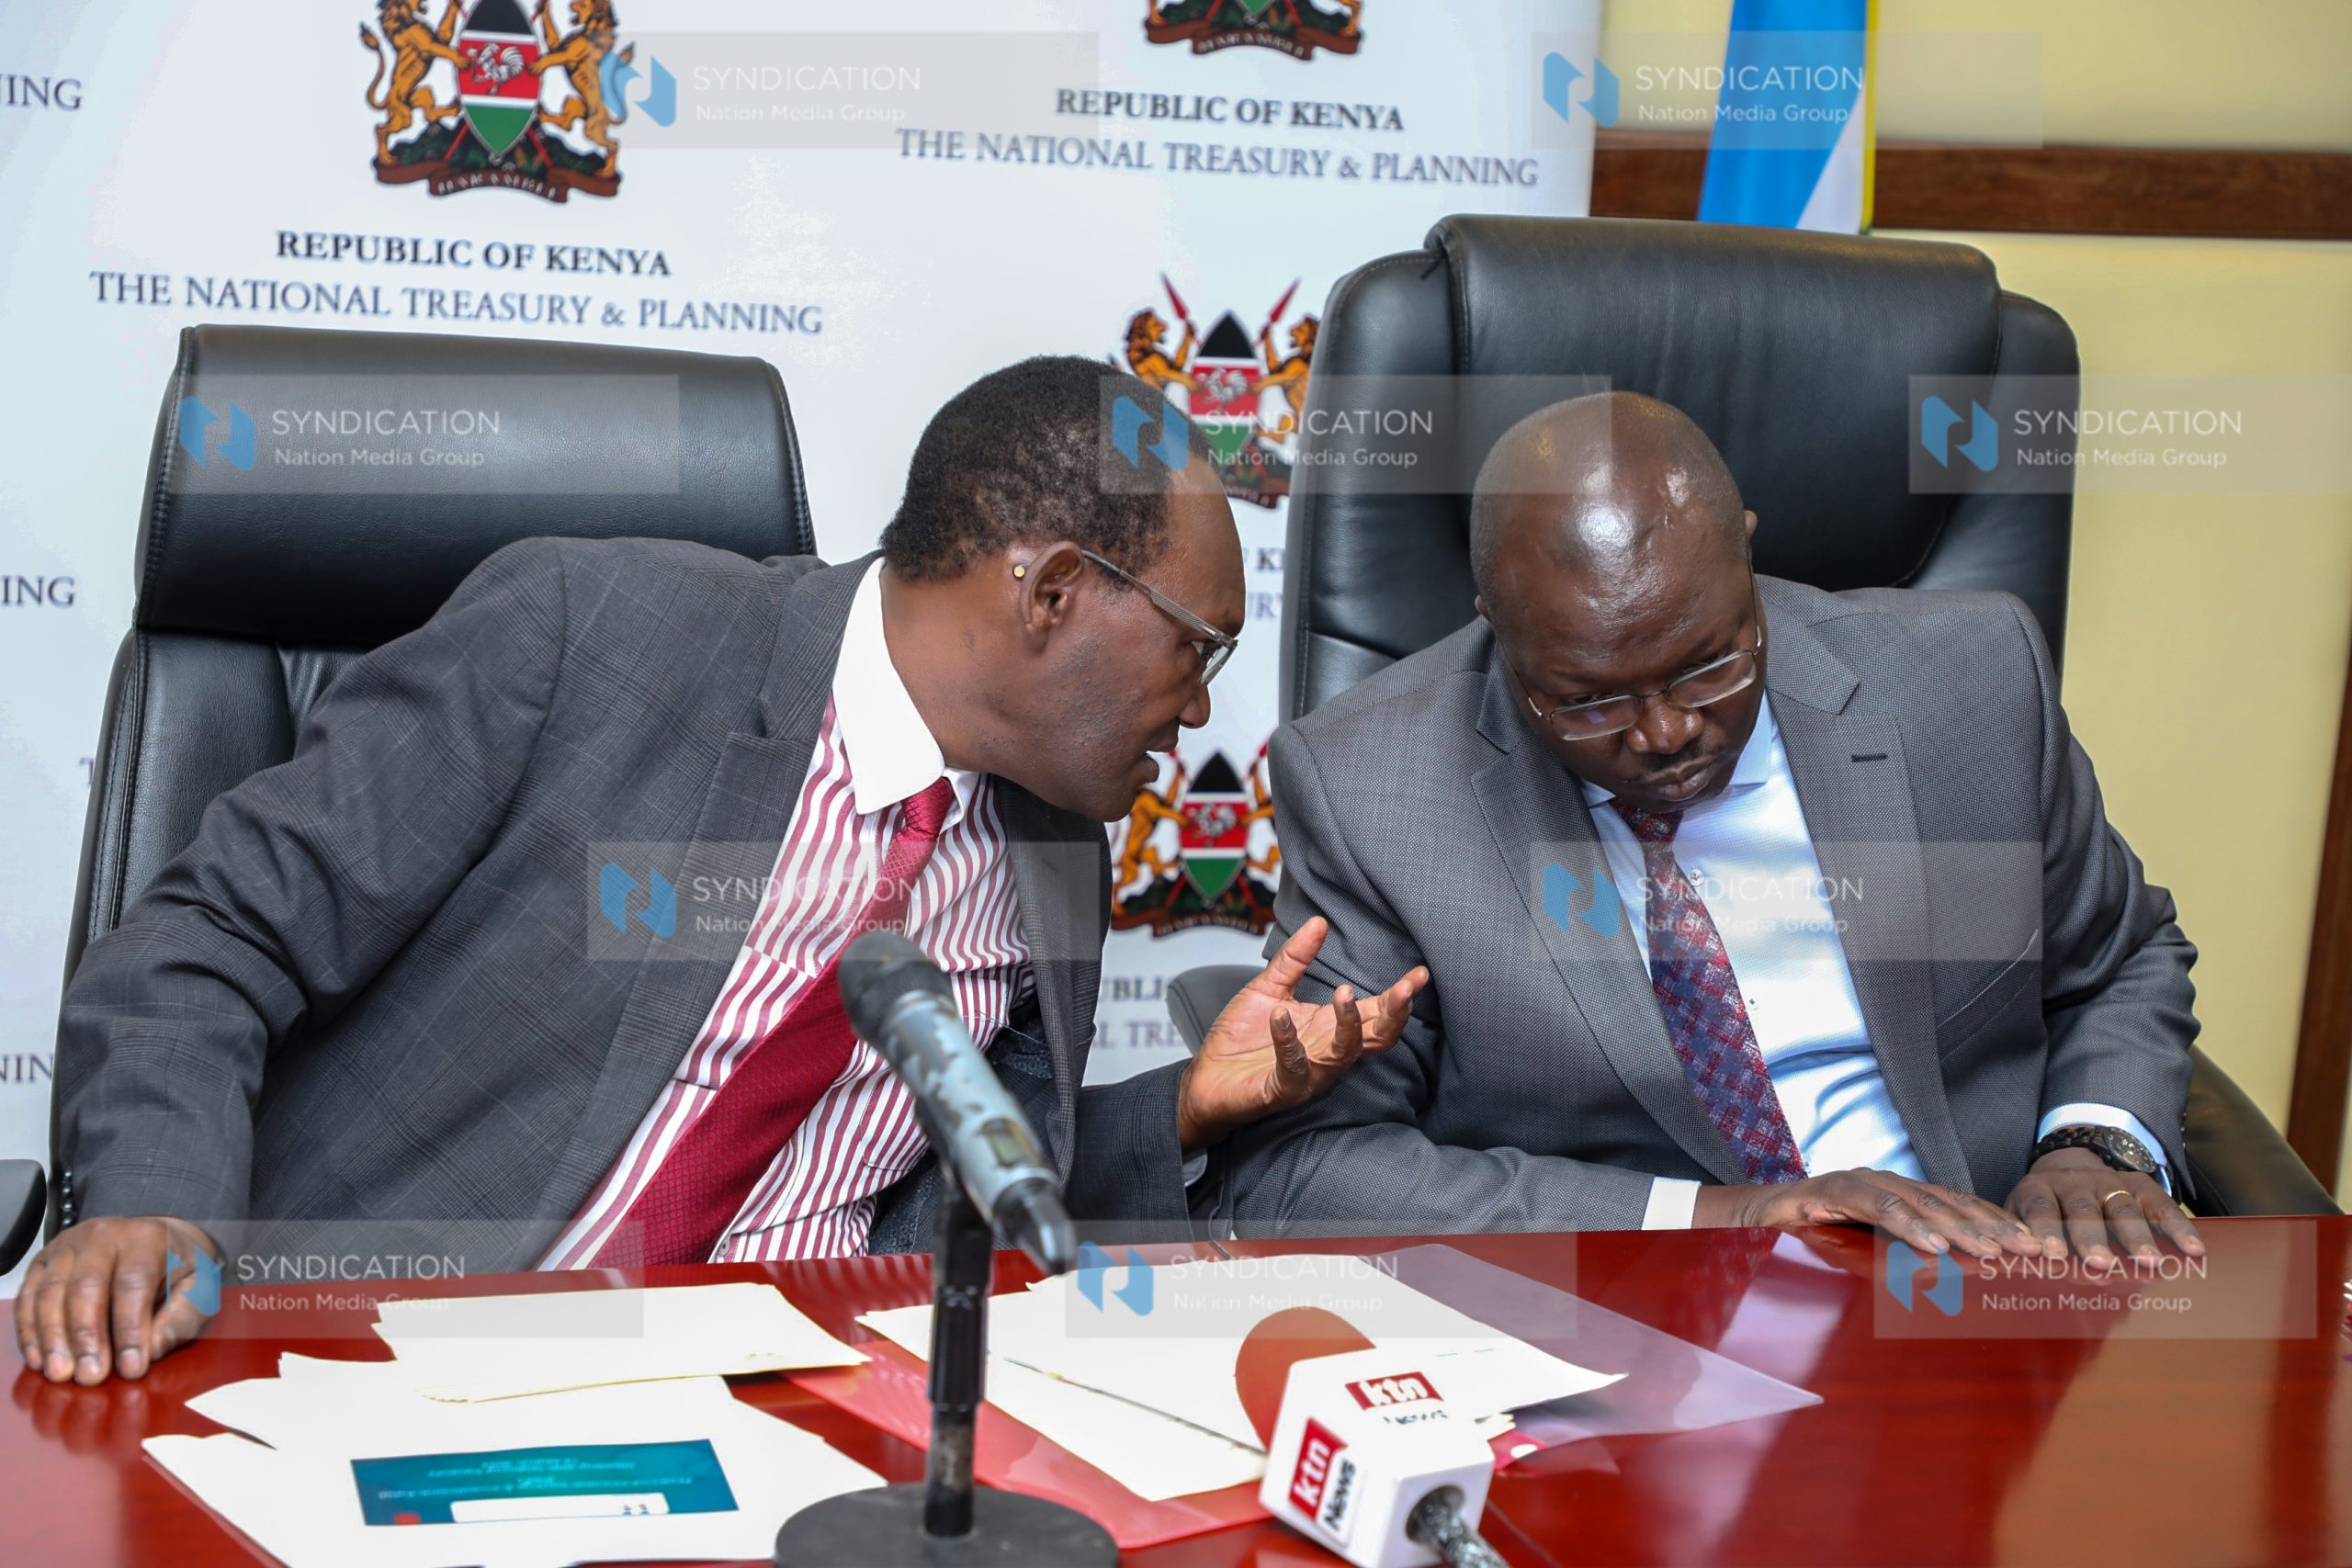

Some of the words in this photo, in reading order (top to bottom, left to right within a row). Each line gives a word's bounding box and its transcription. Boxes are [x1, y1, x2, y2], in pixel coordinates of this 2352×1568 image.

[0, 73, 82, 111] ING
[1056, 88, 1227, 121] REPUBLIC
[1236, 96, 1283, 125] OF
[1290, 100, 1406, 131] KENYA
[895, 128, 966, 160] THE
[976, 132, 1152, 169] NATIONAL
[1163, 141, 1330, 178] TREASURY
[1337, 154, 1361, 179] &
[1372, 151, 1540, 187] PLANNING
[276, 230, 473, 268] REPUBLIC
[482, 241, 536, 270] OF
[547, 243, 672, 277] KENYA
[89, 270, 172, 305] THE
[185, 276, 391, 317] NATIONAL
[401, 286, 594, 328] TREASURY
[600, 302, 626, 328] &
[638, 298, 824, 336] PLANNING
[1357, 1376, 1429, 1407] ktn
[1292, 1438, 1331, 1508] ktn
